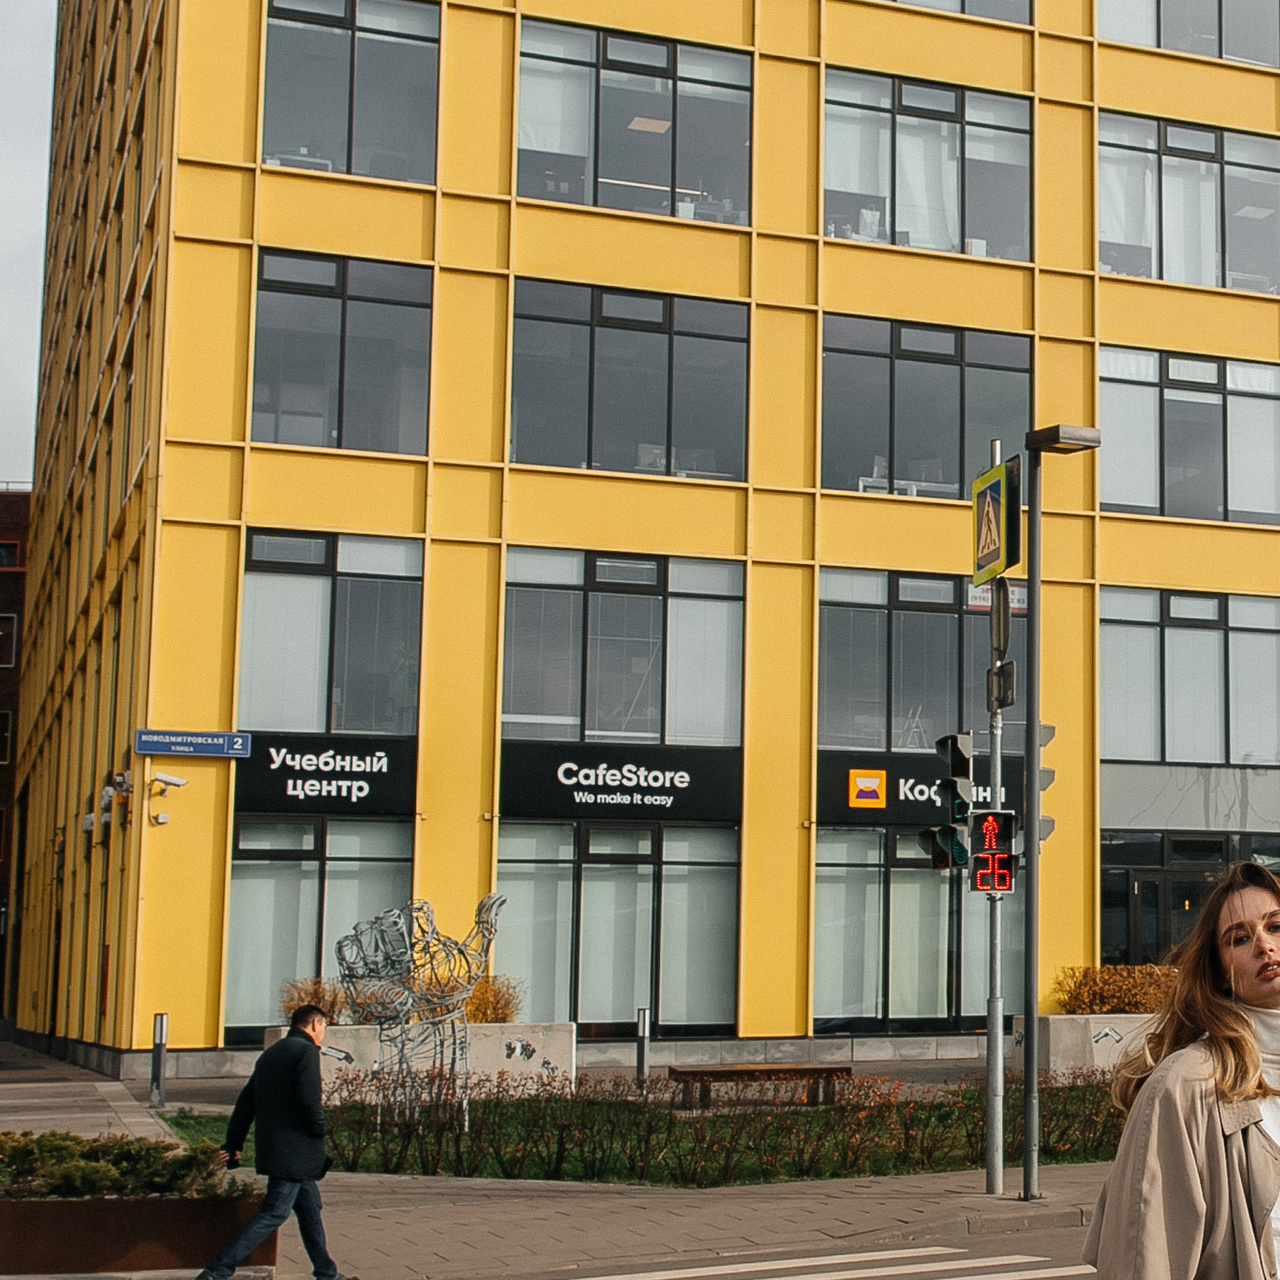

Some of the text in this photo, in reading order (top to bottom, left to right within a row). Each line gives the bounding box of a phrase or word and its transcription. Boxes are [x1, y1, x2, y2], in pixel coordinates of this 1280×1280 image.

[232, 737, 243, 749] 2
[269, 747, 388, 773] Учебный
[557, 762, 691, 788] CafeStore
[286, 778, 370, 802] центр
[573, 791, 674, 808] We make it easy
[976, 853, 1011, 890] 26
